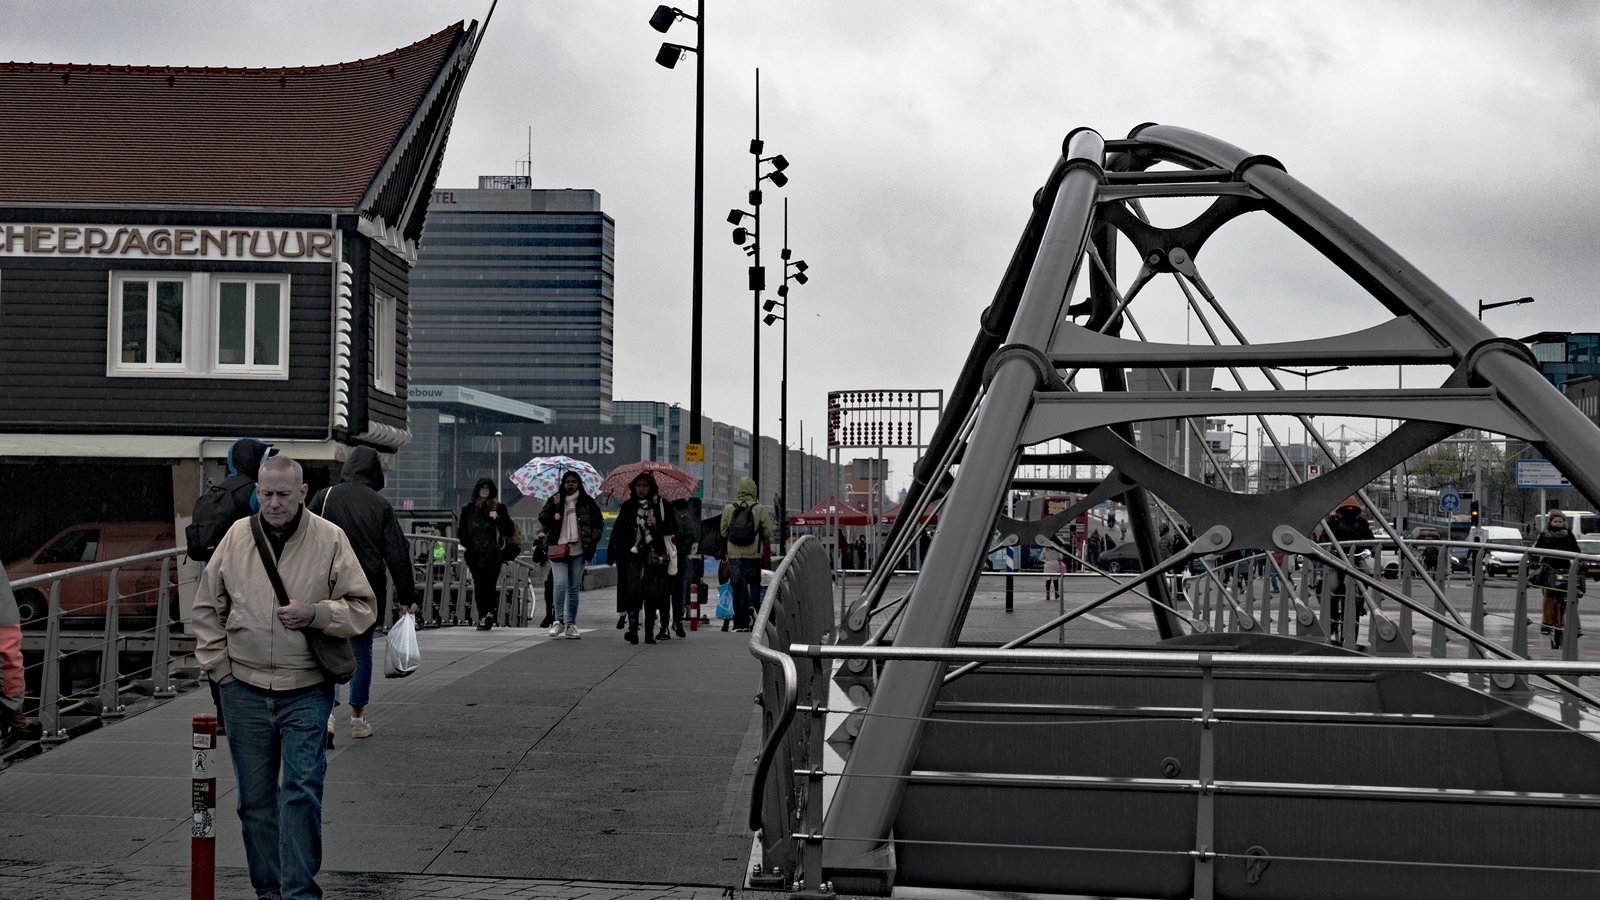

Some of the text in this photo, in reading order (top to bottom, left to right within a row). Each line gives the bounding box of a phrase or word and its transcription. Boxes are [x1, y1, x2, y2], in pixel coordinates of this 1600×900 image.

[431, 192, 457, 204] TEL
[0, 225, 332, 259] HEEPSAGENTUUR
[408, 387, 443, 397] ebouw
[531, 436, 616, 454] BIMHUIS
